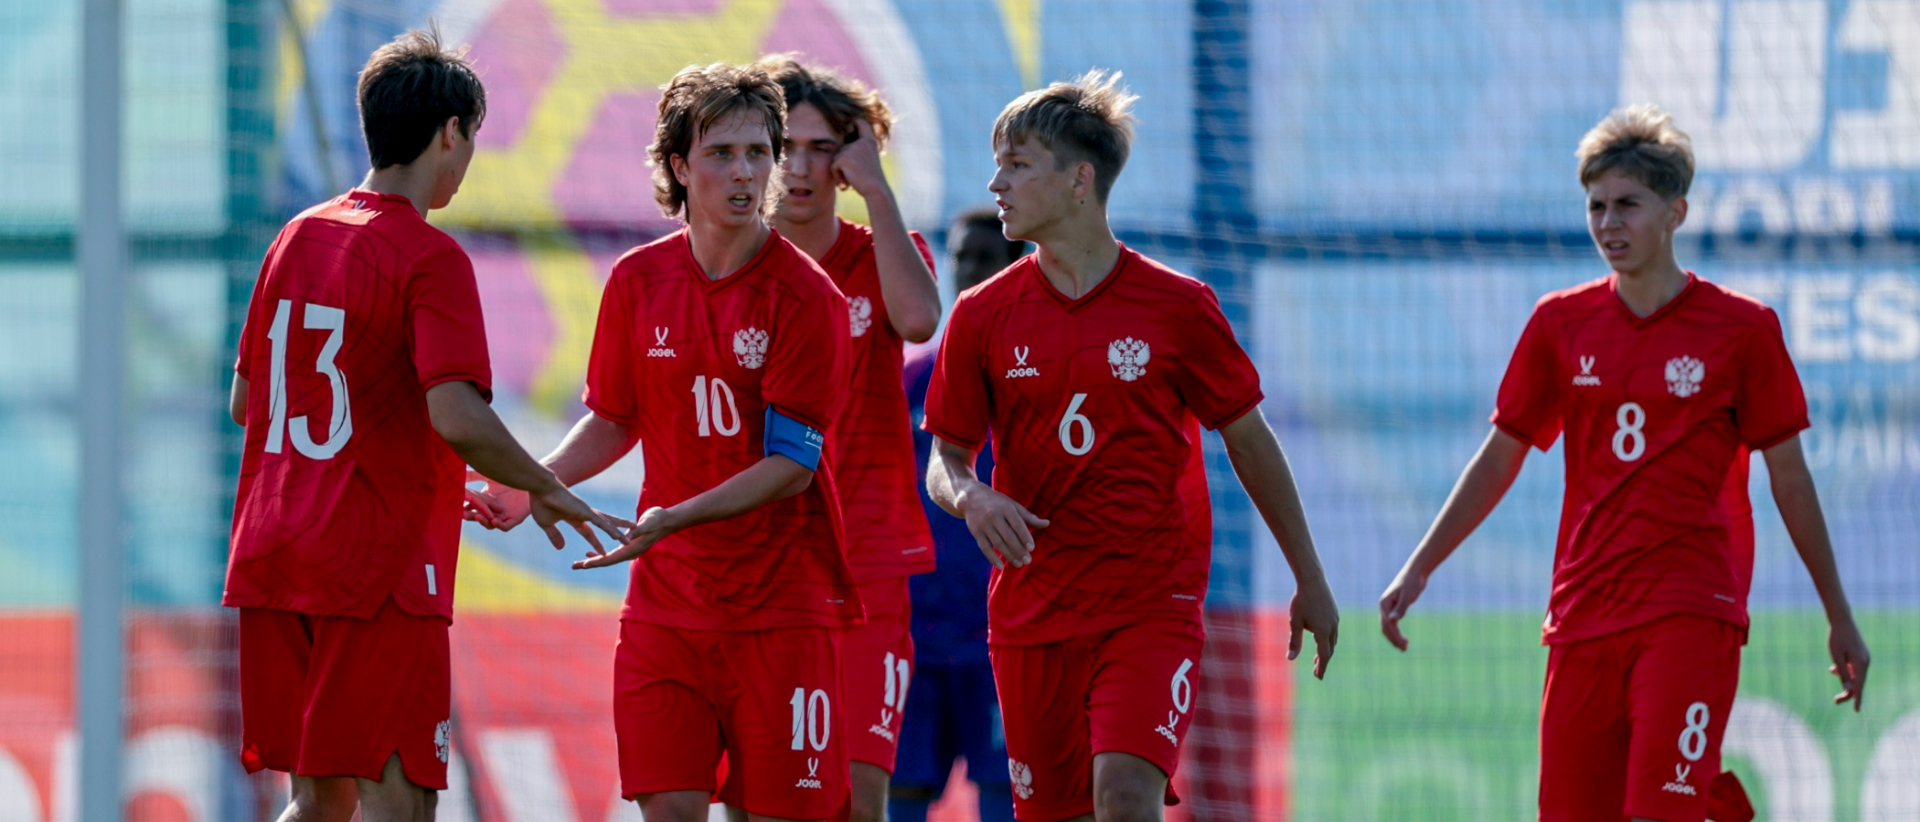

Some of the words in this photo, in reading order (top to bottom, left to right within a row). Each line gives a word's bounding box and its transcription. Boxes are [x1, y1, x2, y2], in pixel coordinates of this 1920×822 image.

[264, 299, 353, 460] 13
[691, 375, 741, 437] 10
[1058, 392, 1096, 456] 6
[1611, 401, 1646, 462] 8
[883, 651, 910, 714] 11
[1170, 657, 1193, 714] 6
[789, 687, 831, 752] 10
[1678, 702, 1710, 762] 8
